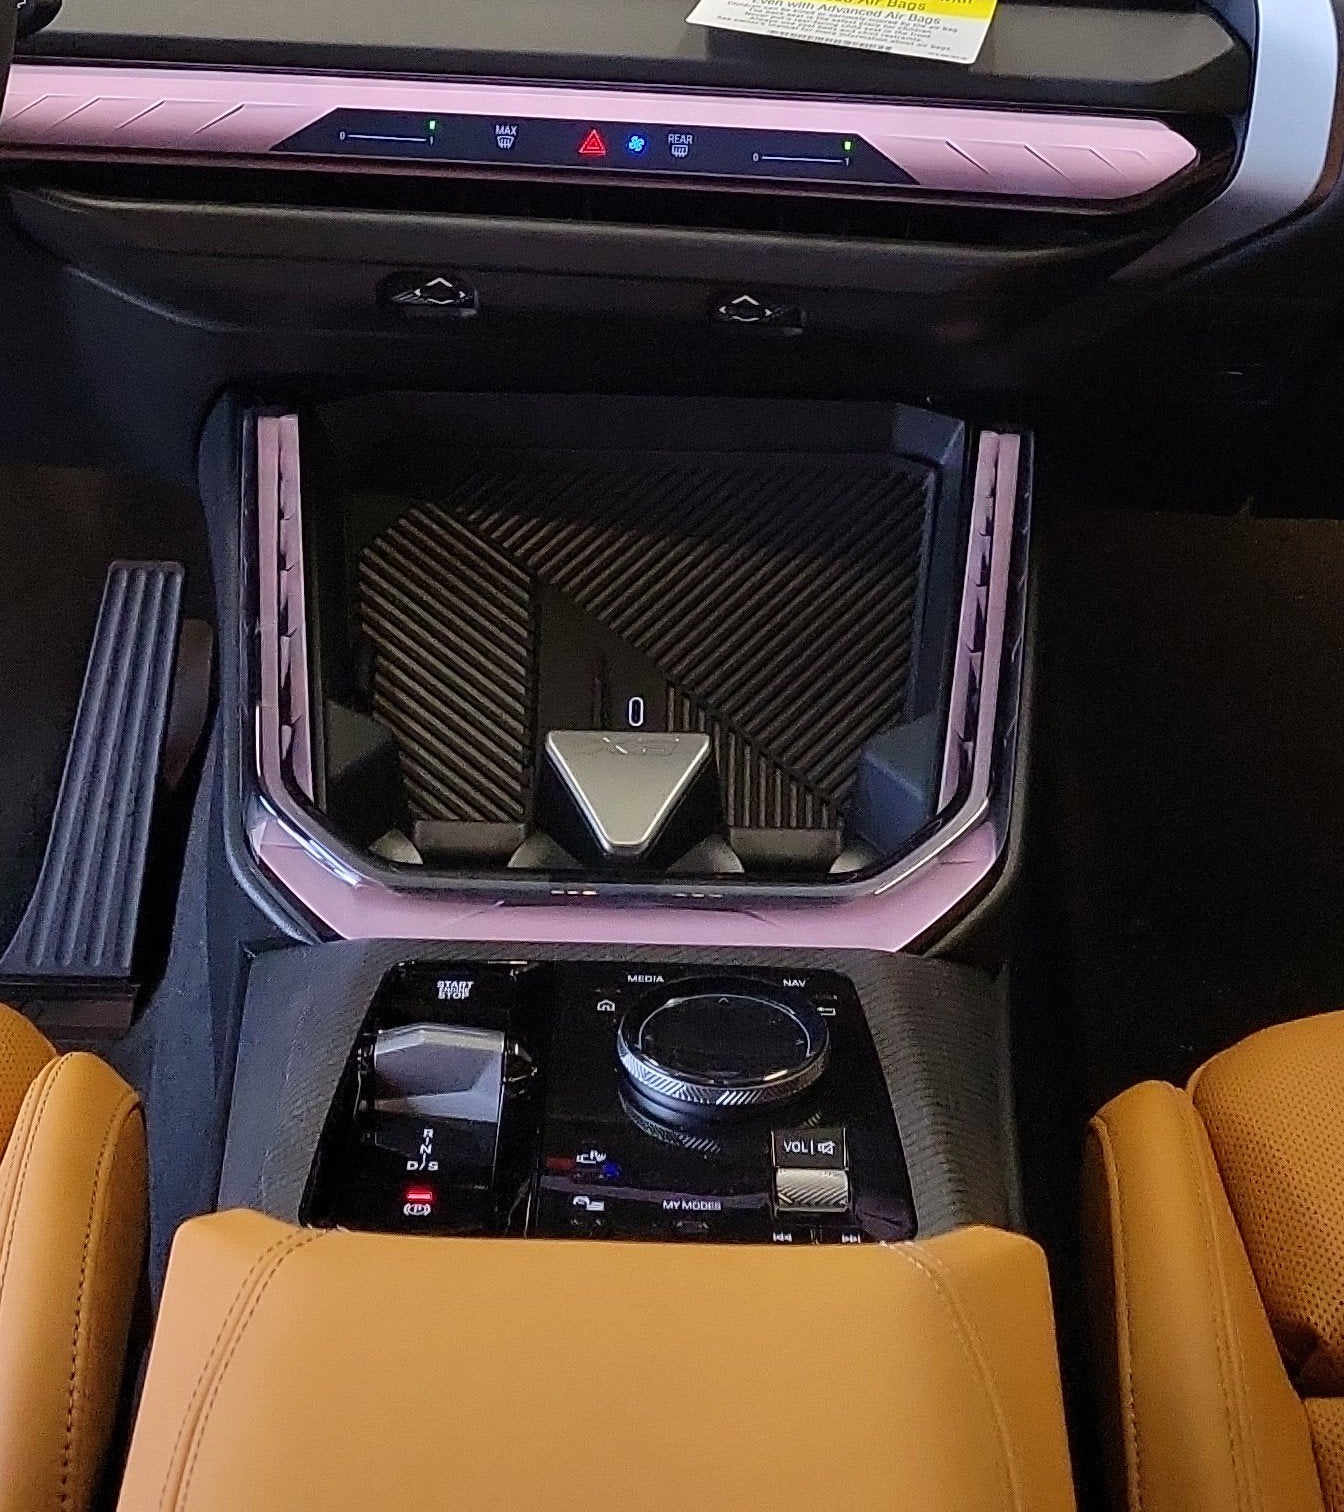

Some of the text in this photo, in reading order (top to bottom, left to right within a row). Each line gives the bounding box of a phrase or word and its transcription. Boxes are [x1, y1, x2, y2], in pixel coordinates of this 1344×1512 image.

[788, 1, 814, 10] with
[818, 3, 882, 18] Advanced
[884, 12, 906, 20] Air
[908, 14, 941, 25] Bags
[495, 124, 518, 136] MAX
[668, 134, 693, 144] REAR
[627, 974, 664, 983] MEDIA
[783, 978, 806, 988] NAV
[437, 980, 474, 989] START
[424, 1128, 434, 1138] R
[420, 1144, 432, 1154] N
[783, 1140, 808, 1153] VOL
[406, 1160, 439, 1170] D S
[662, 1200, 722, 1212] MY MODES
